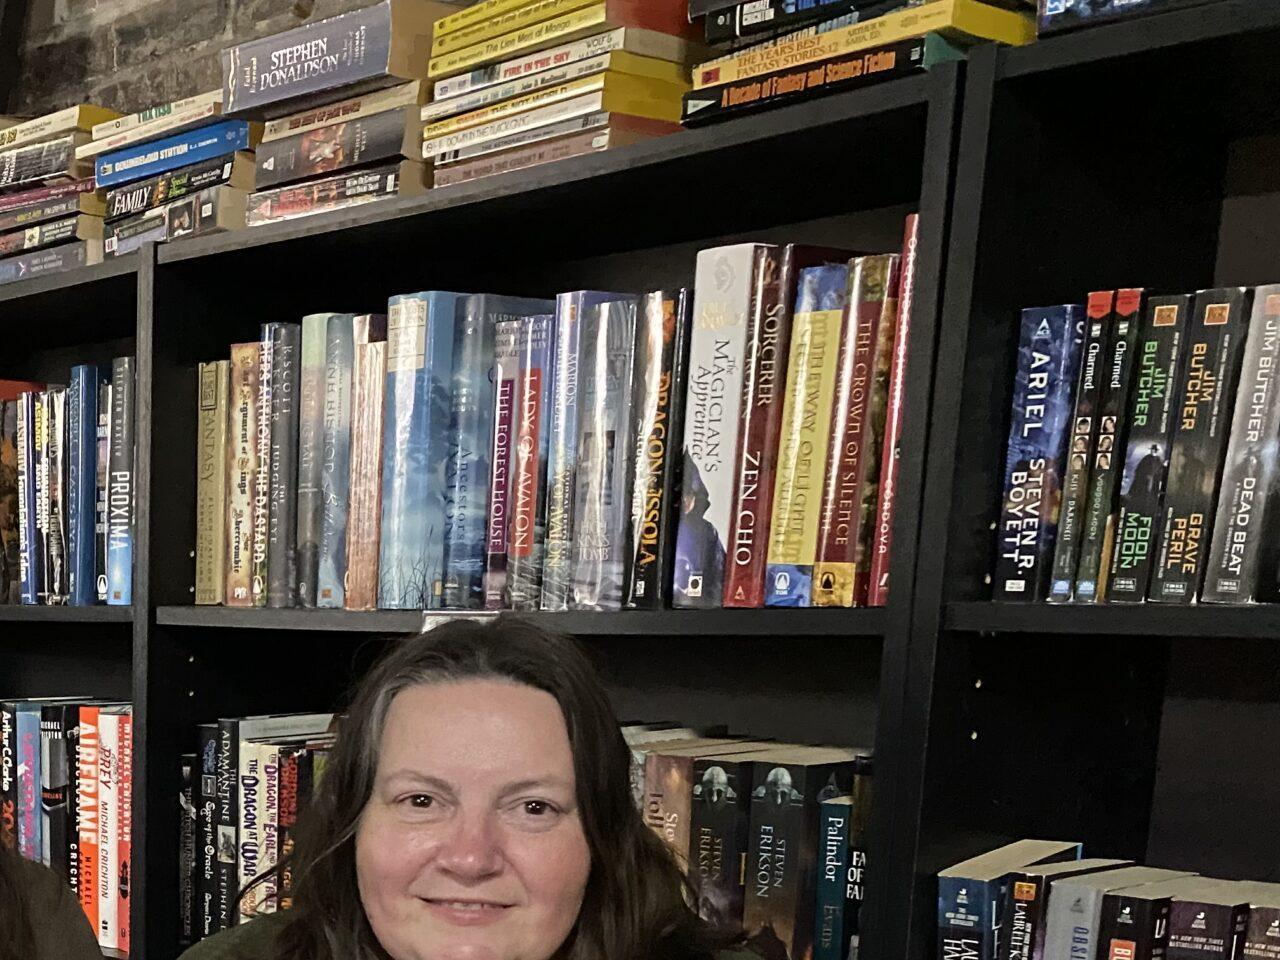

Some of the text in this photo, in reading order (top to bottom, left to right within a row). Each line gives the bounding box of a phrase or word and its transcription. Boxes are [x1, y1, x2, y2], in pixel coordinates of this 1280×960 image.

[271, 37, 327, 70] STEPHEN
[545, 20, 570, 34] Mongo
[737, 53, 753, 68] THE
[260, 54, 340, 91] DONALDSON
[504, 51, 570, 78] FIRE IN THE SKY
[721, 89, 728, 107] A
[772, 72, 806, 95] Fantasy
[807, 66, 824, 88] and
[826, 58, 862, 83] Science
[863, 50, 896, 75] Fiction
[113, 186, 152, 216] FAMILY
[726, 357, 736, 375] The
[758, 303, 785, 407] SORCERER
[1084, 342, 1100, 390] Charmed
[1110, 341, 1128, 388] Charmed
[1133, 341, 1159, 427] BUTCHER
[1150, 368, 1165, 399] JIM
[1181, 342, 1207, 431] BUTCHER
[1200, 371, 1216, 402] JIM
[1246, 320, 1280, 443] JIM BUTCHER
[521, 375, 537, 430] LADY
[648, 371, 672, 472] DRAGON
[692, 365, 708, 461] Apprentice
[706, 339, 730, 473] MAGICIAN'S
[1023, 351, 1051, 437] ARIEL
[201, 407, 214, 483] FANTASY
[490, 383, 511, 547] THE FOREST HOUSE
[835, 319, 874, 546] THE CROWN OF SILENCE
[111, 471, 130, 551] PROXIMA
[270, 444, 280, 545] JUDGING EYE
[514, 477, 532, 548] AVALON
[735, 450, 761, 567] ZEN CHO
[1002, 471, 1028, 563] BOYETT
[1016, 458, 1045, 576] STEVEN R.
[1228, 477, 1256, 575] DEAD BEAT
[1120, 511, 1141, 569] MOON
[1131, 516, 1152, 566] FOOL
[1167, 517, 1188, 570] PERIL
[1181, 513, 1203, 575] GRAVE
[1, 711, 13, 741] Arthur
[79, 721, 100, 845] AIRFRAME
[99, 745, 113, 791] PREY
[99, 801, 109, 899] MICHAEL CRICHTON
[240, 758, 259, 877] THE DRAGON AT WAR
[825, 816, 845, 882] Palindor
[756, 824, 775, 898] ERIKSON
[774, 838, 786, 889] STEVEN
